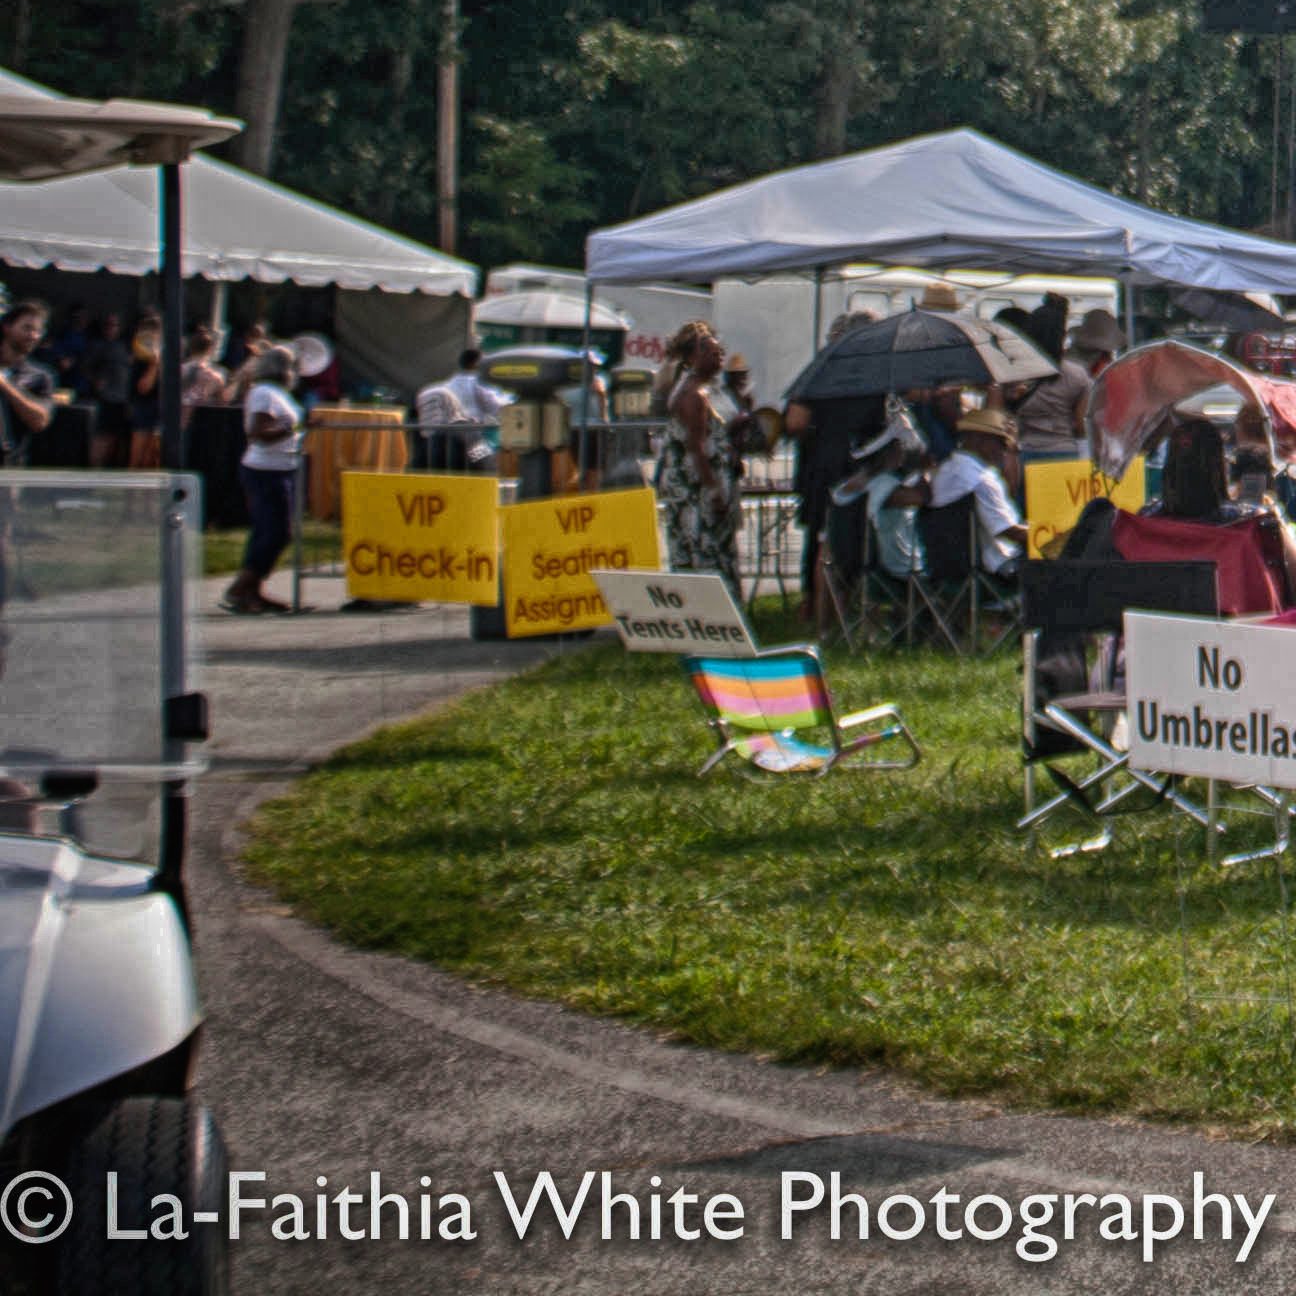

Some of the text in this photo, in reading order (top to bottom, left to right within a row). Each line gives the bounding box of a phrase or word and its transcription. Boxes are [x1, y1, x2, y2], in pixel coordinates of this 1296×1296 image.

[396, 494, 445, 527] VIP
[556, 505, 597, 535] VIP
[350, 544, 493, 582] Check-in
[531, 546, 629, 581] Seating
[647, 584, 683, 609] No
[616, 615, 745, 643] Tents Here
[1198, 645, 1242, 690] No
